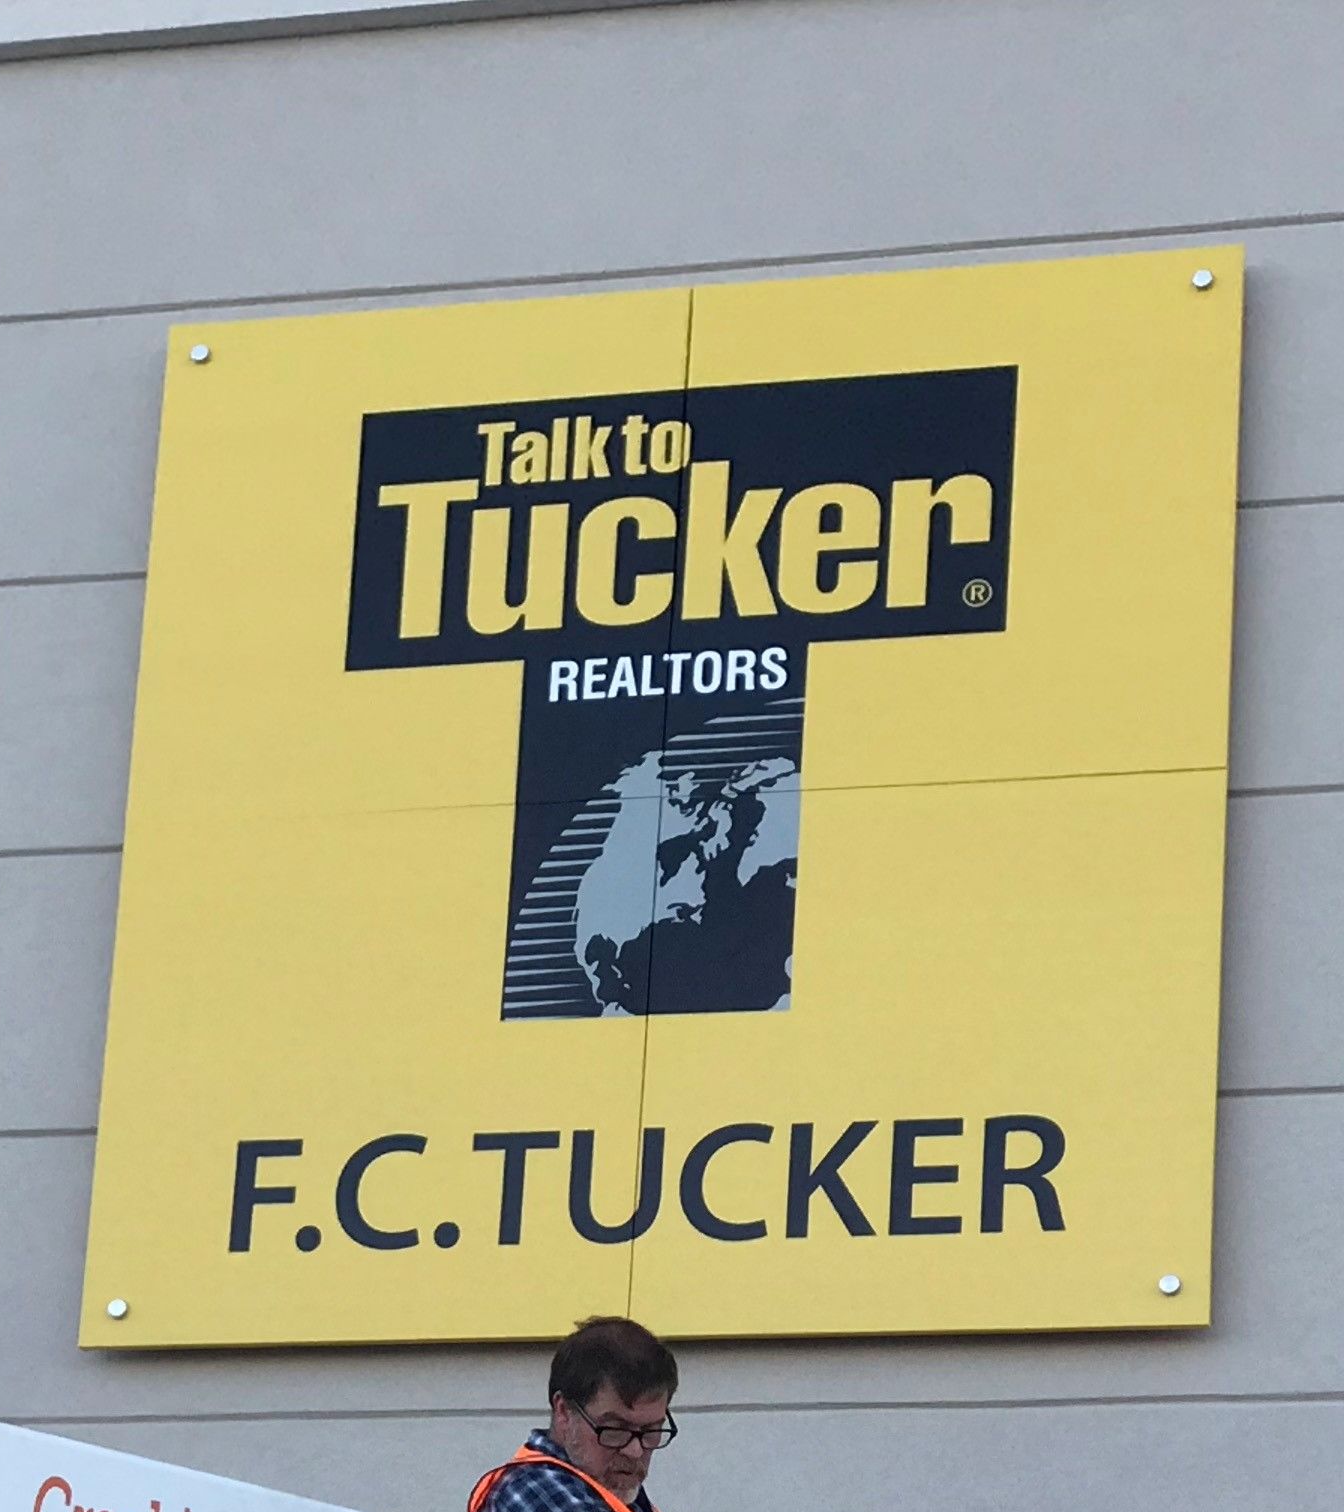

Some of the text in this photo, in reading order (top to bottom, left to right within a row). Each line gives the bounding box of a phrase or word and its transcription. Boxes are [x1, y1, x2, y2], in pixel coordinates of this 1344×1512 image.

[477, 412, 691, 487] Talk to
[548, 647, 788, 703] REALTORS
